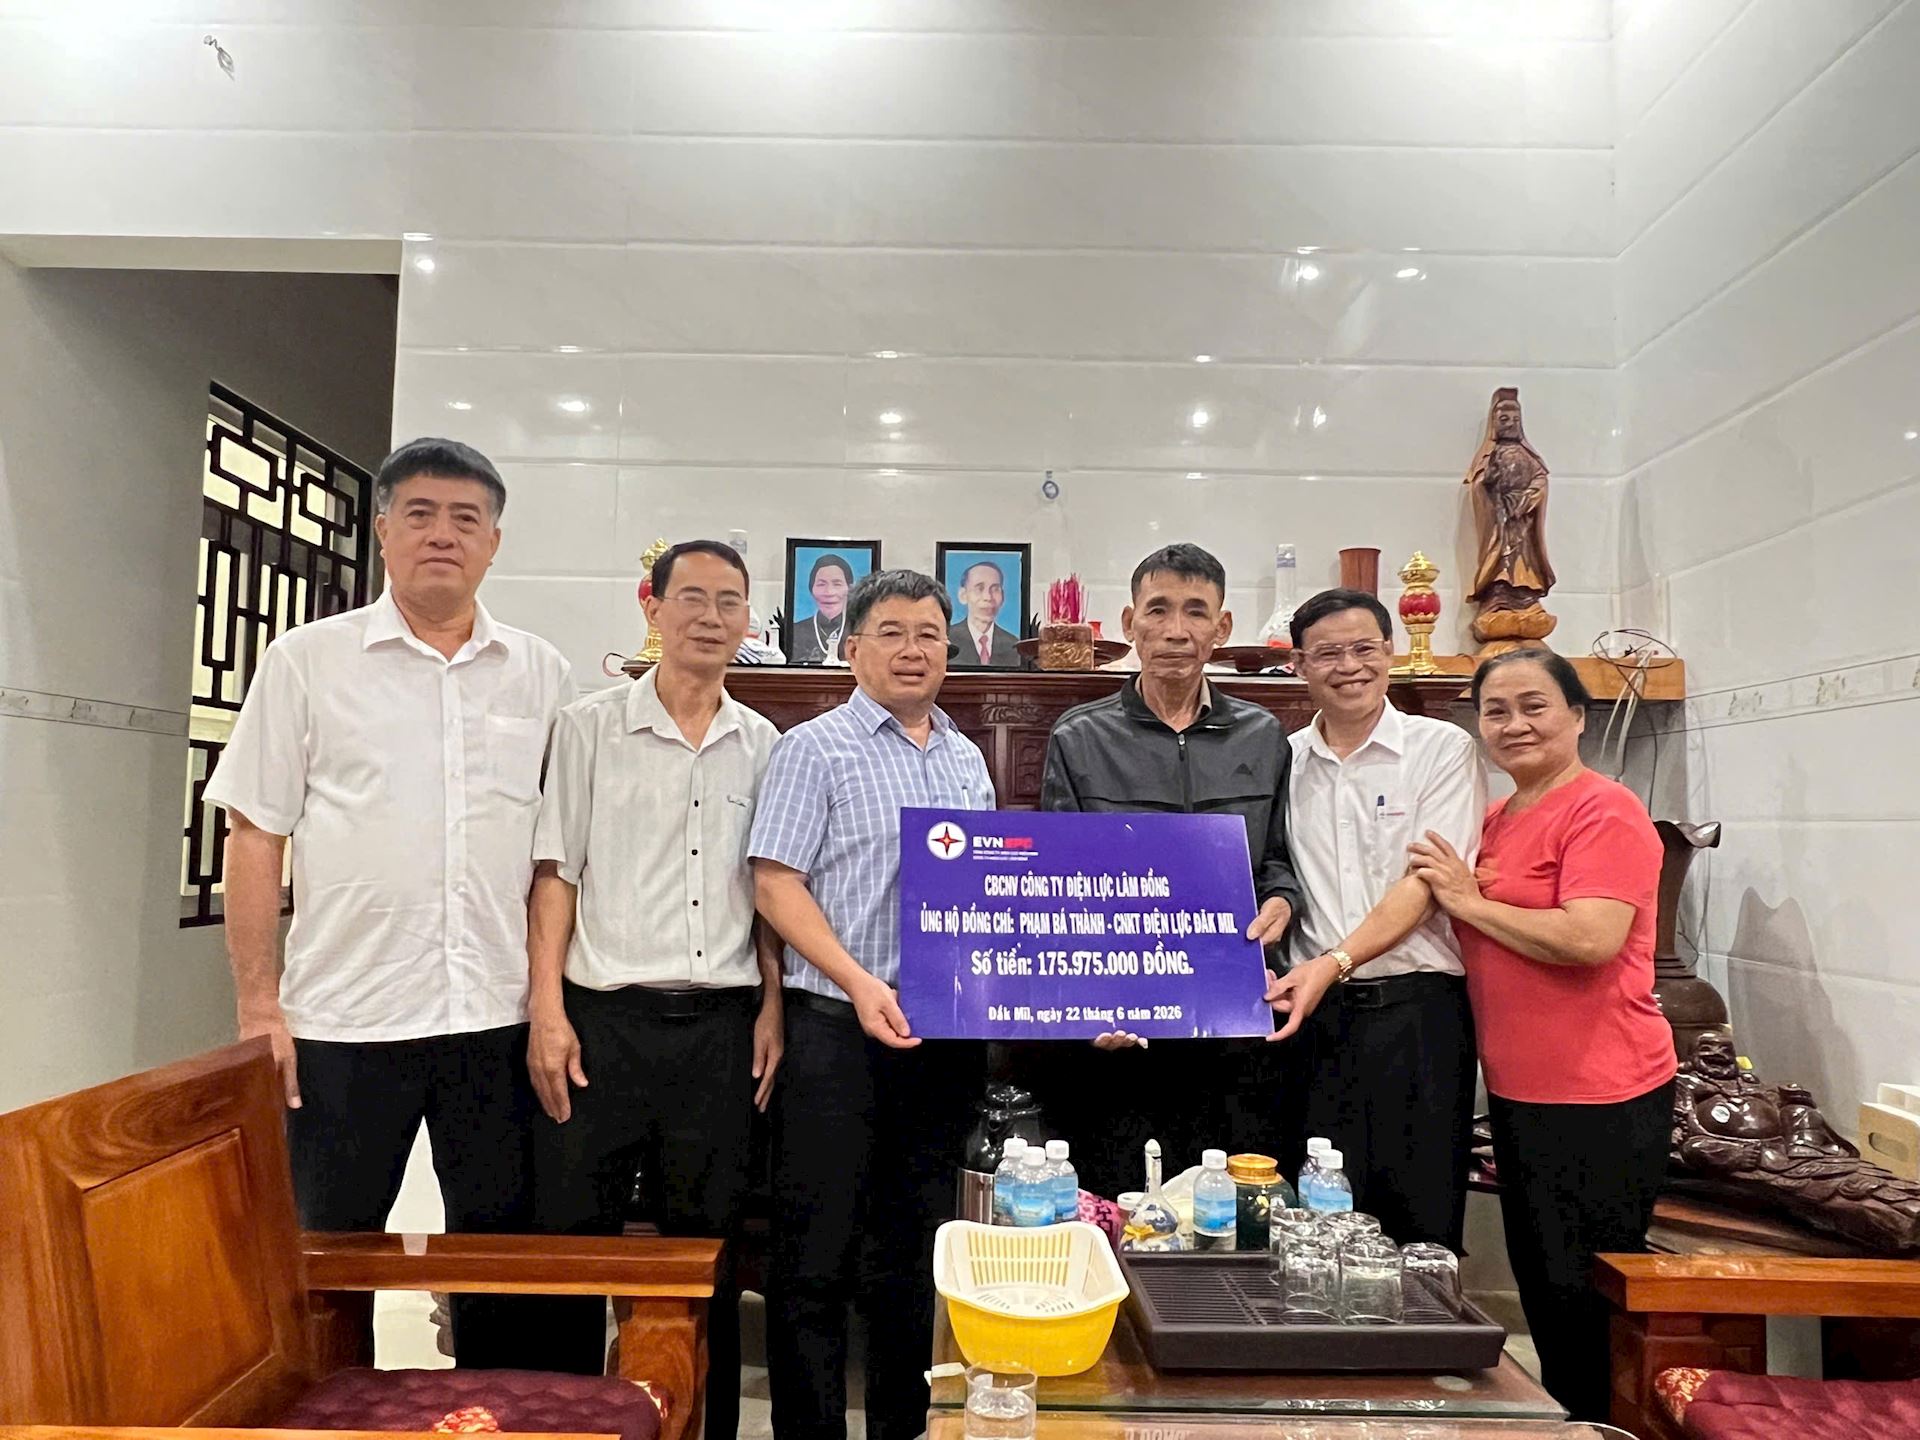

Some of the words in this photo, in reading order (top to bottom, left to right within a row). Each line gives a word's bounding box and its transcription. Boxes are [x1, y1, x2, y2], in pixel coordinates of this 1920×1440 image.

[984, 874, 1018, 897] CBCNV
[1020, 870, 1049, 897] CÔNG
[1050, 876, 1064, 897] TY
[1066, 871, 1092, 902] ĐIỆN
[1093, 873, 1114, 902] LỰC
[1116, 871, 1139, 897] LÂM
[1141, 867, 1170, 898] ĐỒNG
[944, 905, 960, 937] HỘ
[962, 902, 992, 934] ĐỒNG
[1019, 912, 1051, 939] PHẠM
[1052, 907, 1068, 935] BÁ
[1069, 907, 1105, 935] THÀNH
[1142, 907, 1170, 938] ĐIỆN
[1170, 909, 1192, 939] LỰC
[971, 948, 994, 976] Số
[996, 942, 1033, 976] tiền:
[1037, 951, 1139, 976] 175.975.000
[1142, 941, 1195, 976] ĐỒNG.
[1036, 1007, 1062, 1023] ngày
[1065, 1006, 1080, 1021] 22
[1083, 1006, 1115, 1024] tháng
[1116, 1006, 1125, 1020] 6
[1127, 1007, 1151, 1020] năm
[1153, 1005, 1183, 1020] 2026
